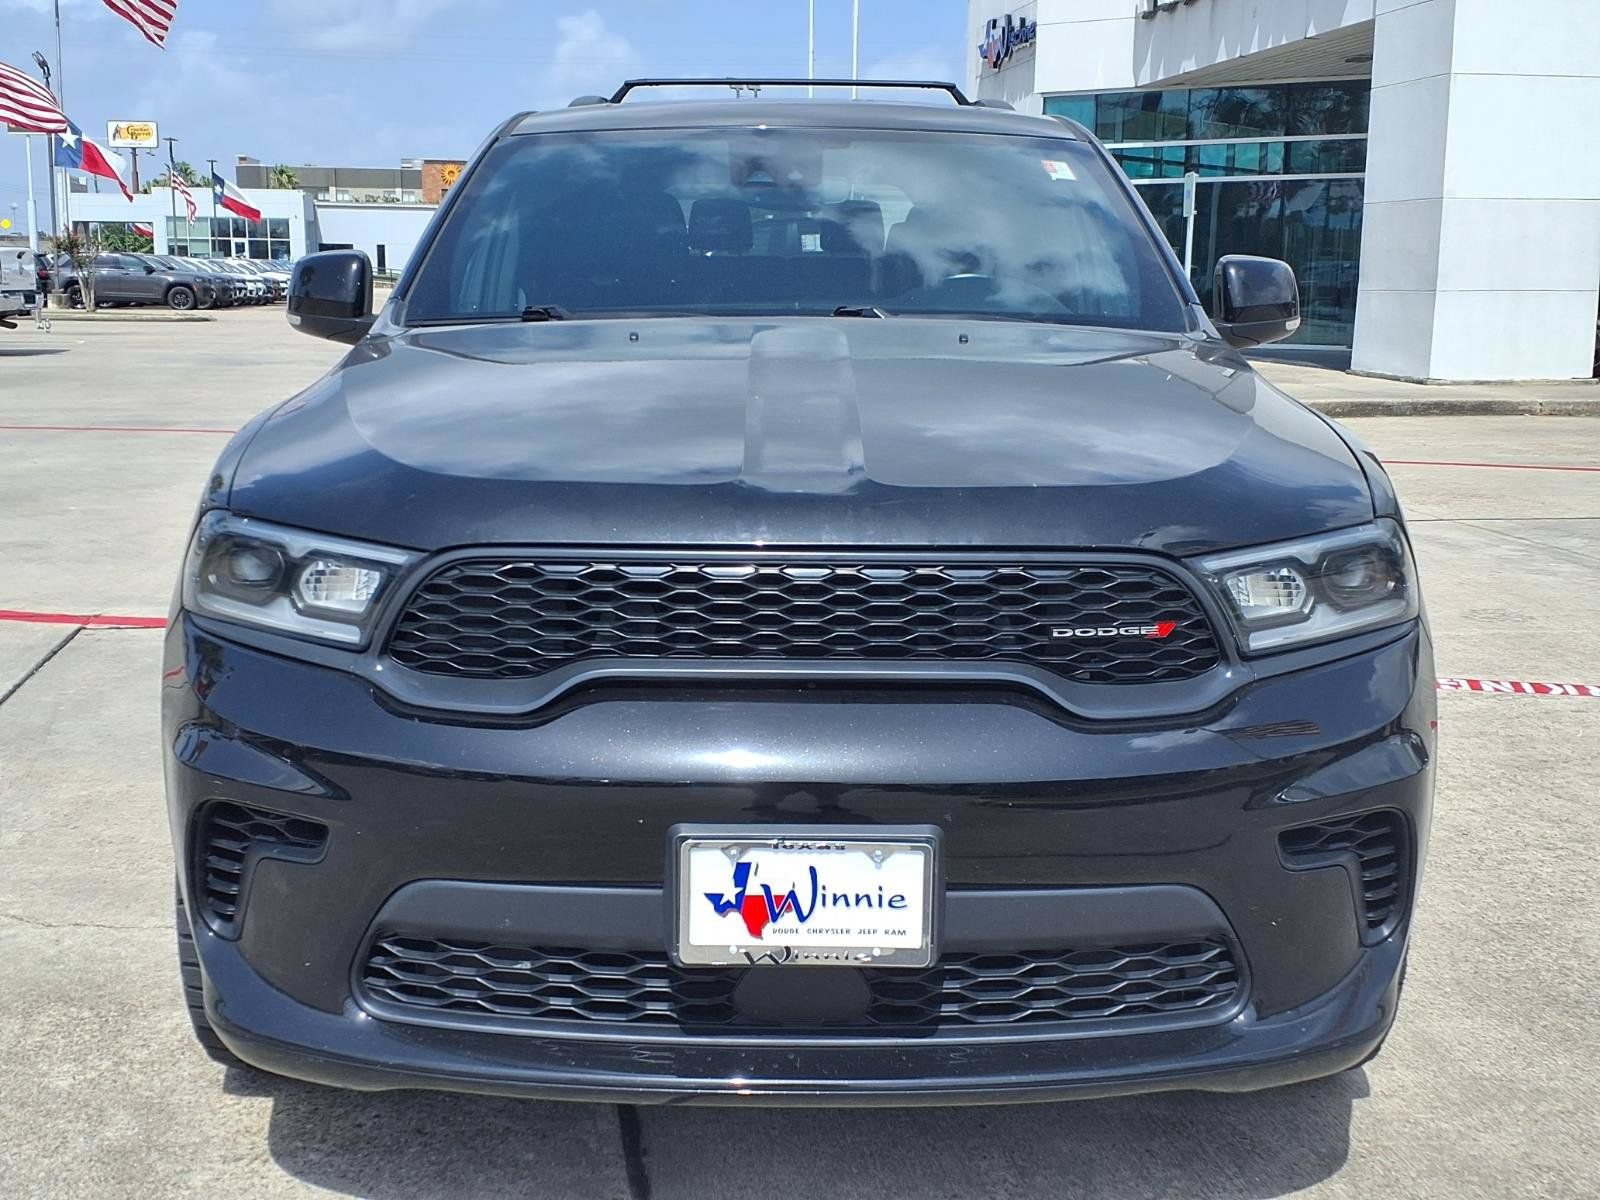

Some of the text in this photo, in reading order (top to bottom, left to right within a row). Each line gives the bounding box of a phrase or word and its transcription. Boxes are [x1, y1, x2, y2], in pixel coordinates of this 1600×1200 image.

[1052, 626, 1160, 638] DODGE
[760, 865, 908, 923] Winnie
[772, 927, 800, 935] DODGE
